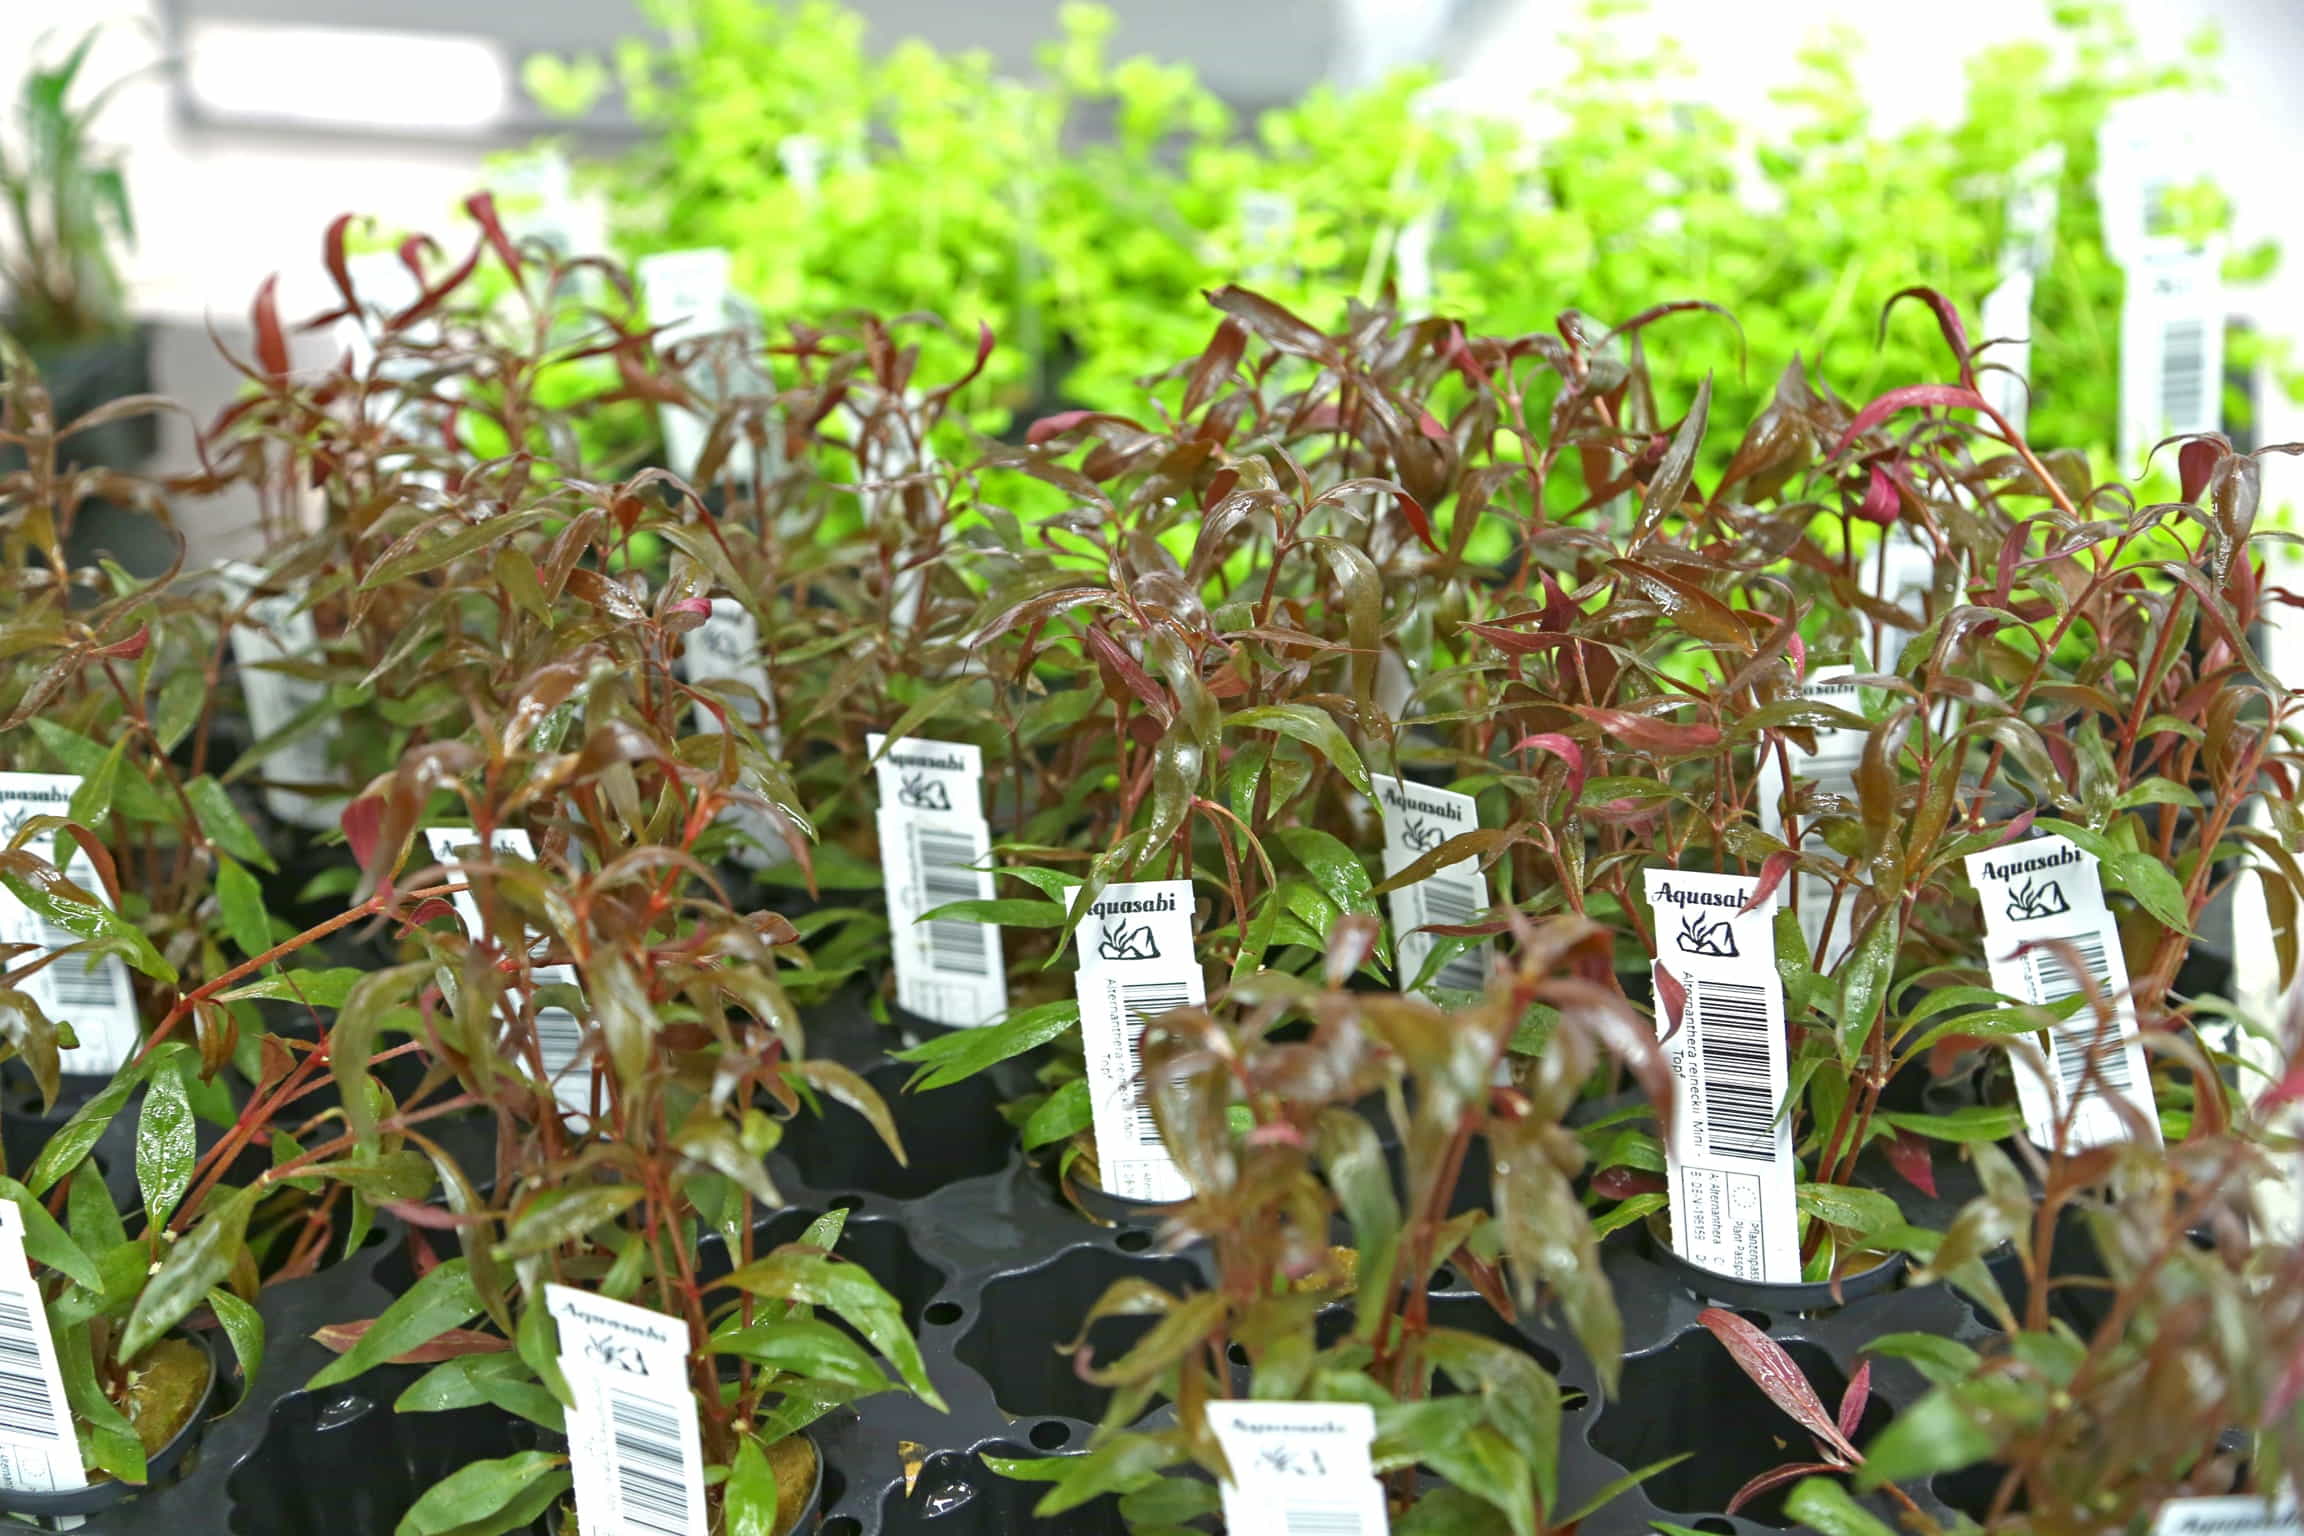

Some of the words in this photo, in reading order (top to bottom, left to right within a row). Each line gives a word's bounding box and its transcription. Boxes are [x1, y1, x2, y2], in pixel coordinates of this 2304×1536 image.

[1981, 844, 2083, 883] Aquasabi
[1651, 882, 1757, 909] Aquasab
[1672, 1049, 1687, 1079] Topf
[1732, 1245, 1745, 1280] Passpo
